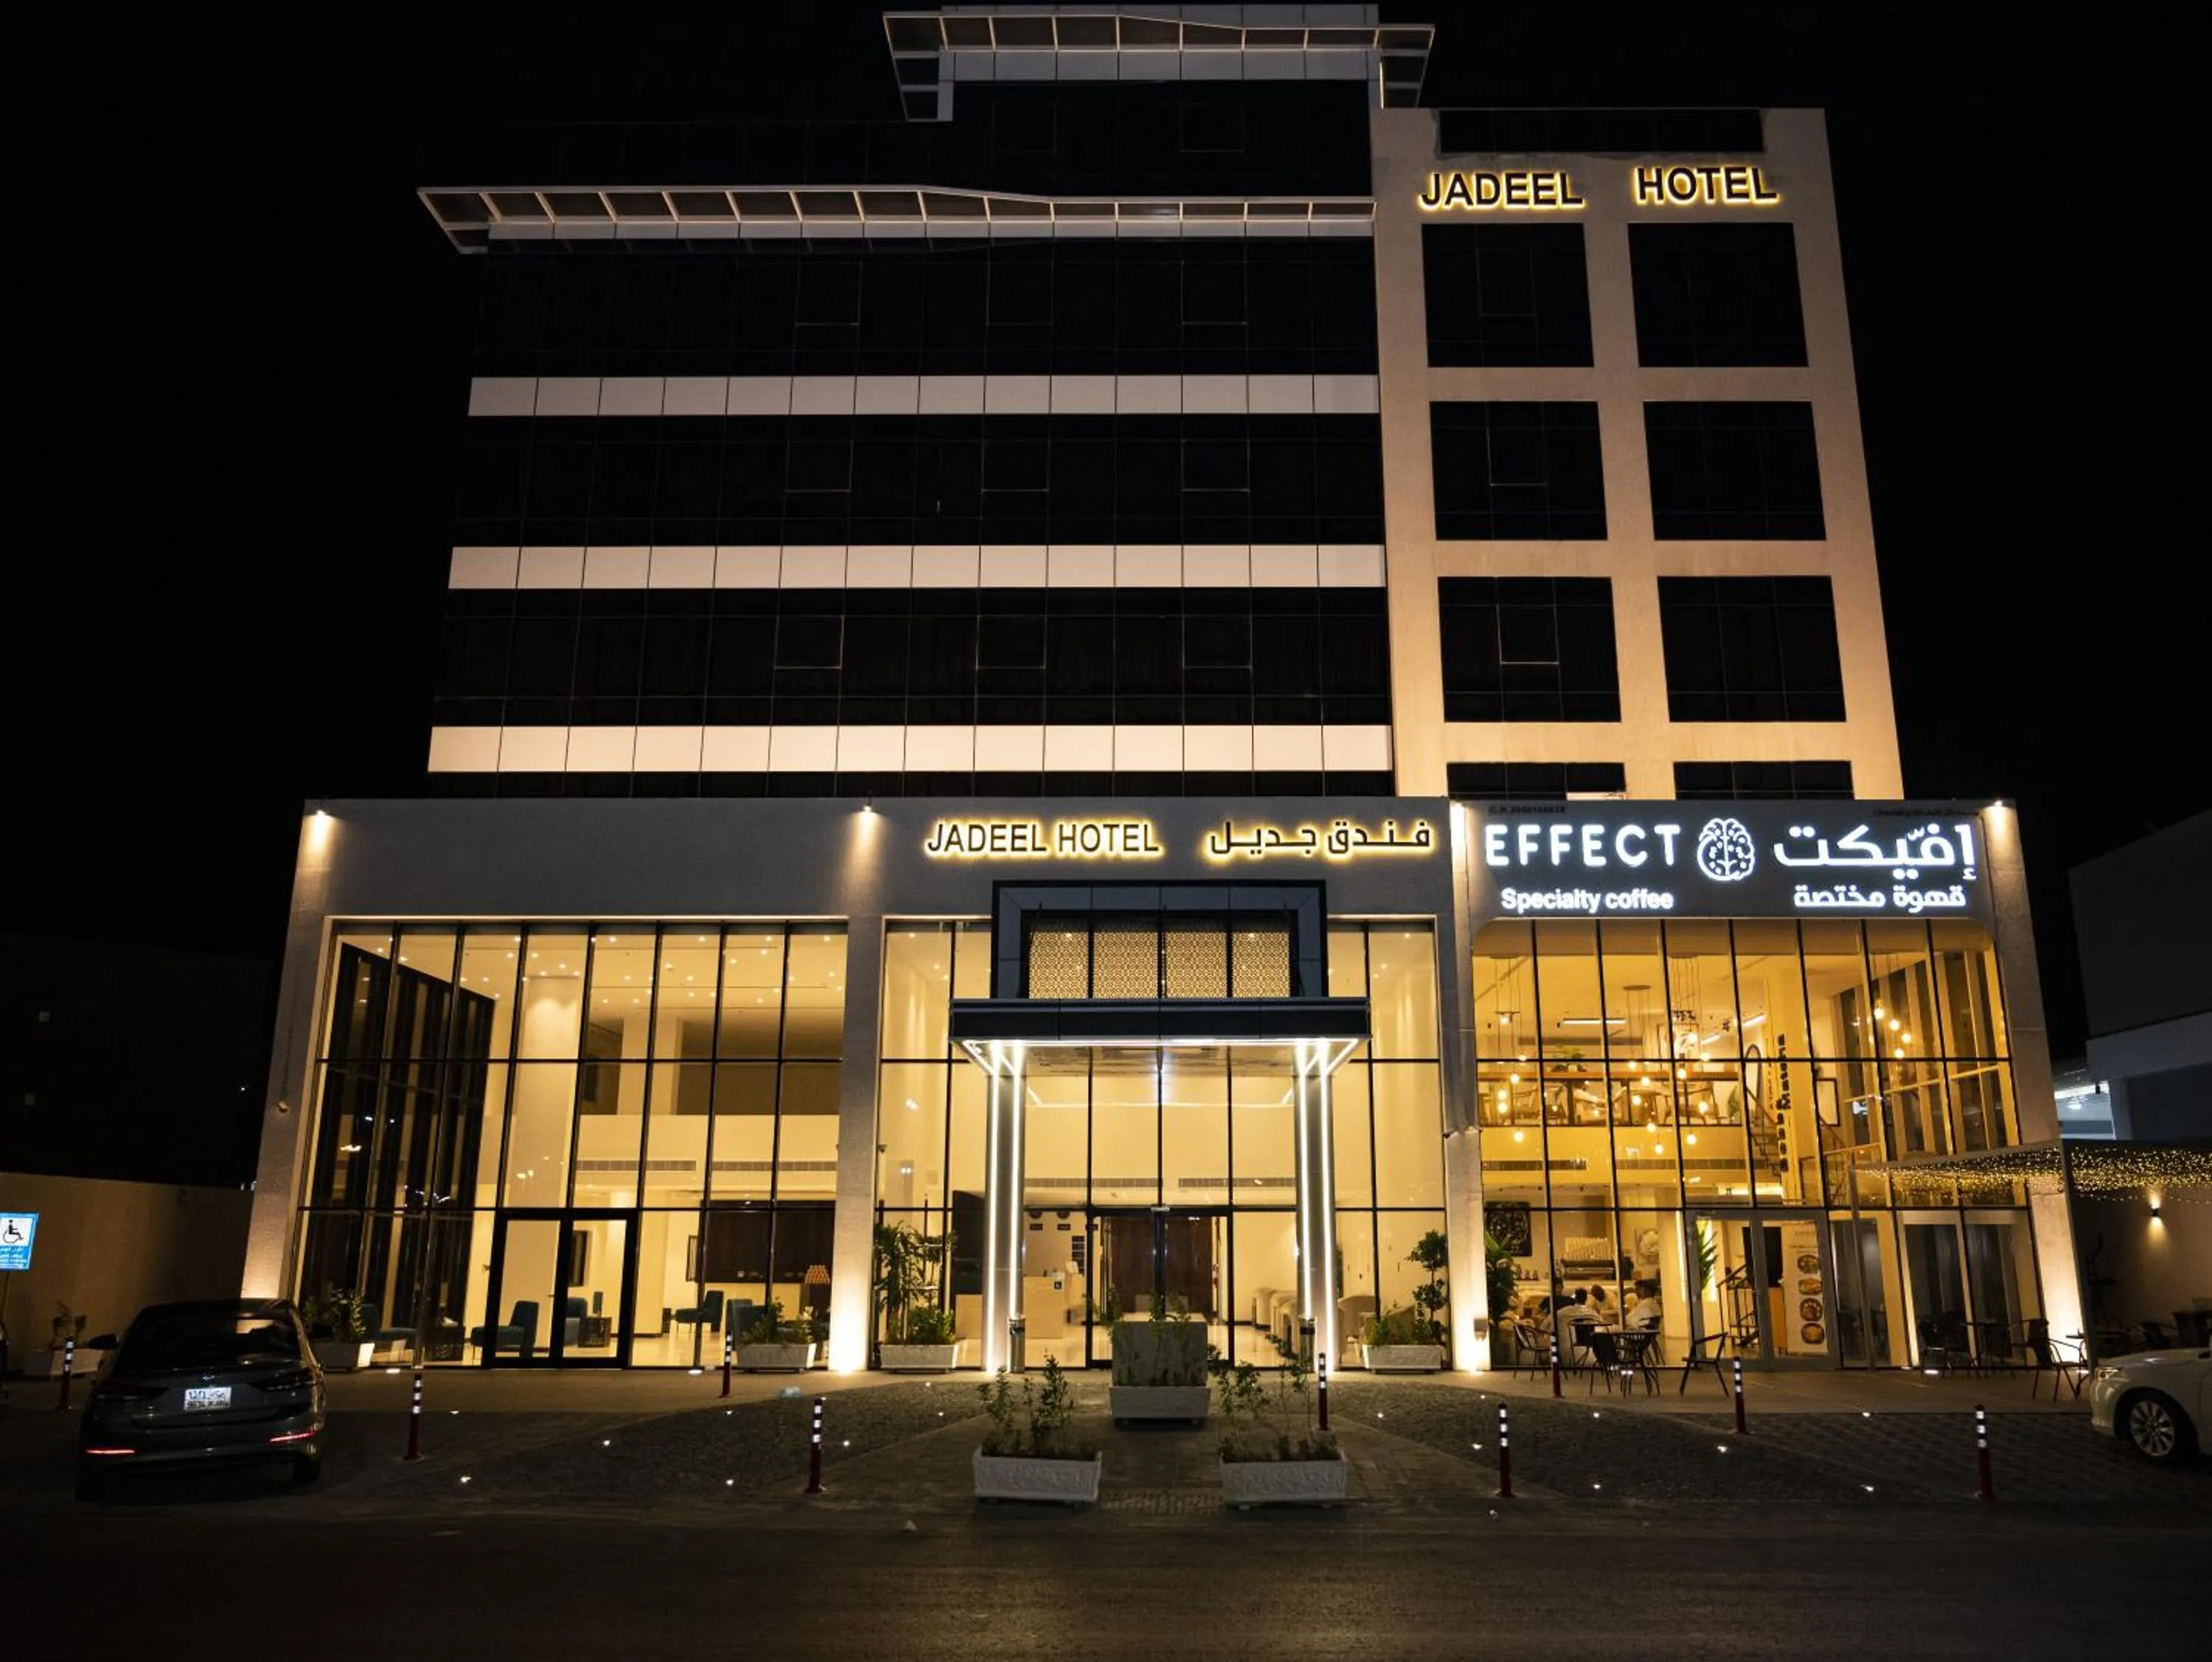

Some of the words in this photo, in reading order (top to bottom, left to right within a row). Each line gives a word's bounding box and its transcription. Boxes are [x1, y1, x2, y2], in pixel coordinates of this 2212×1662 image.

[1420, 172, 1585, 207] JADEEL
[1635, 166, 1778, 201] HOTEL
[927, 822, 1048, 853] JADEEL
[1057, 822, 1161, 853] HOTEL
[1210, 820, 1317, 855] جديل
[1327, 820, 1430, 855] فندق
[1484, 824, 1682, 868] EFFECT
[1500, 887, 1601, 914] Specialty
[1604, 888, 1674, 910] coffee
[1793, 884, 1887, 908] مختصة
[1892, 884, 1967, 914] قهوة
